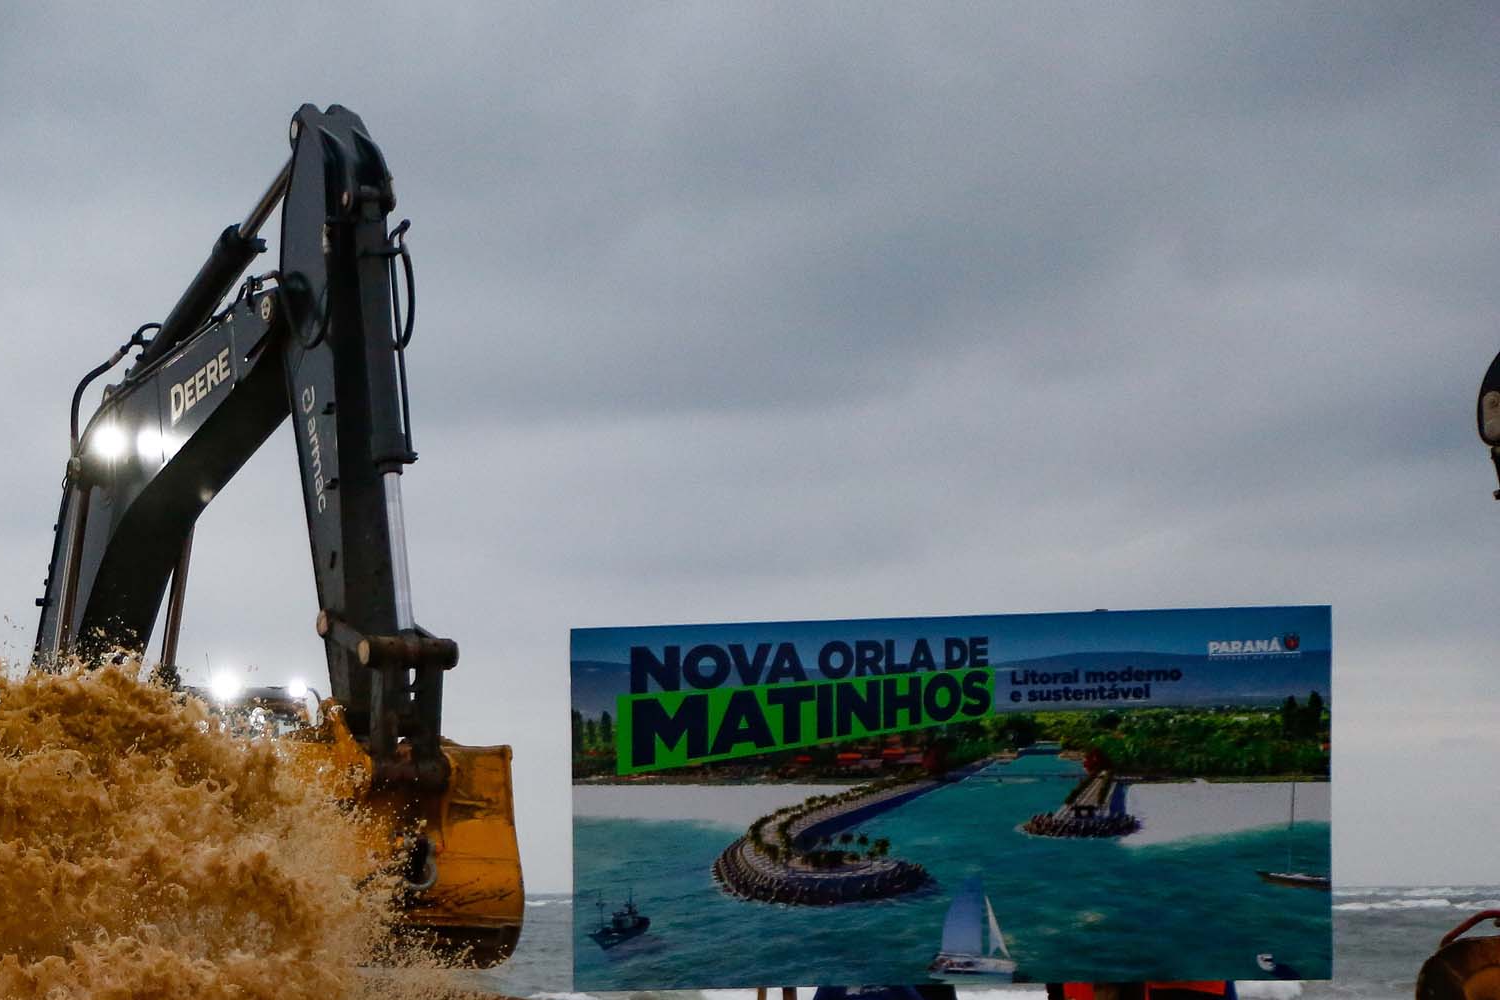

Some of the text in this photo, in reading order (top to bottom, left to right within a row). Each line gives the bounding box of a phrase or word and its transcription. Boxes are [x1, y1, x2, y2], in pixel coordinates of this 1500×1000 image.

[170, 347, 231, 426] DEERE
[630, 636, 989, 694] NOVA ORLA DE
[1208, 636, 1280, 656] PARANÁ
[1009, 684, 1150, 702] e sustentável
[1011, 665, 1183, 685] Litoral moderno
[631, 670, 992, 768] MATINHOS
